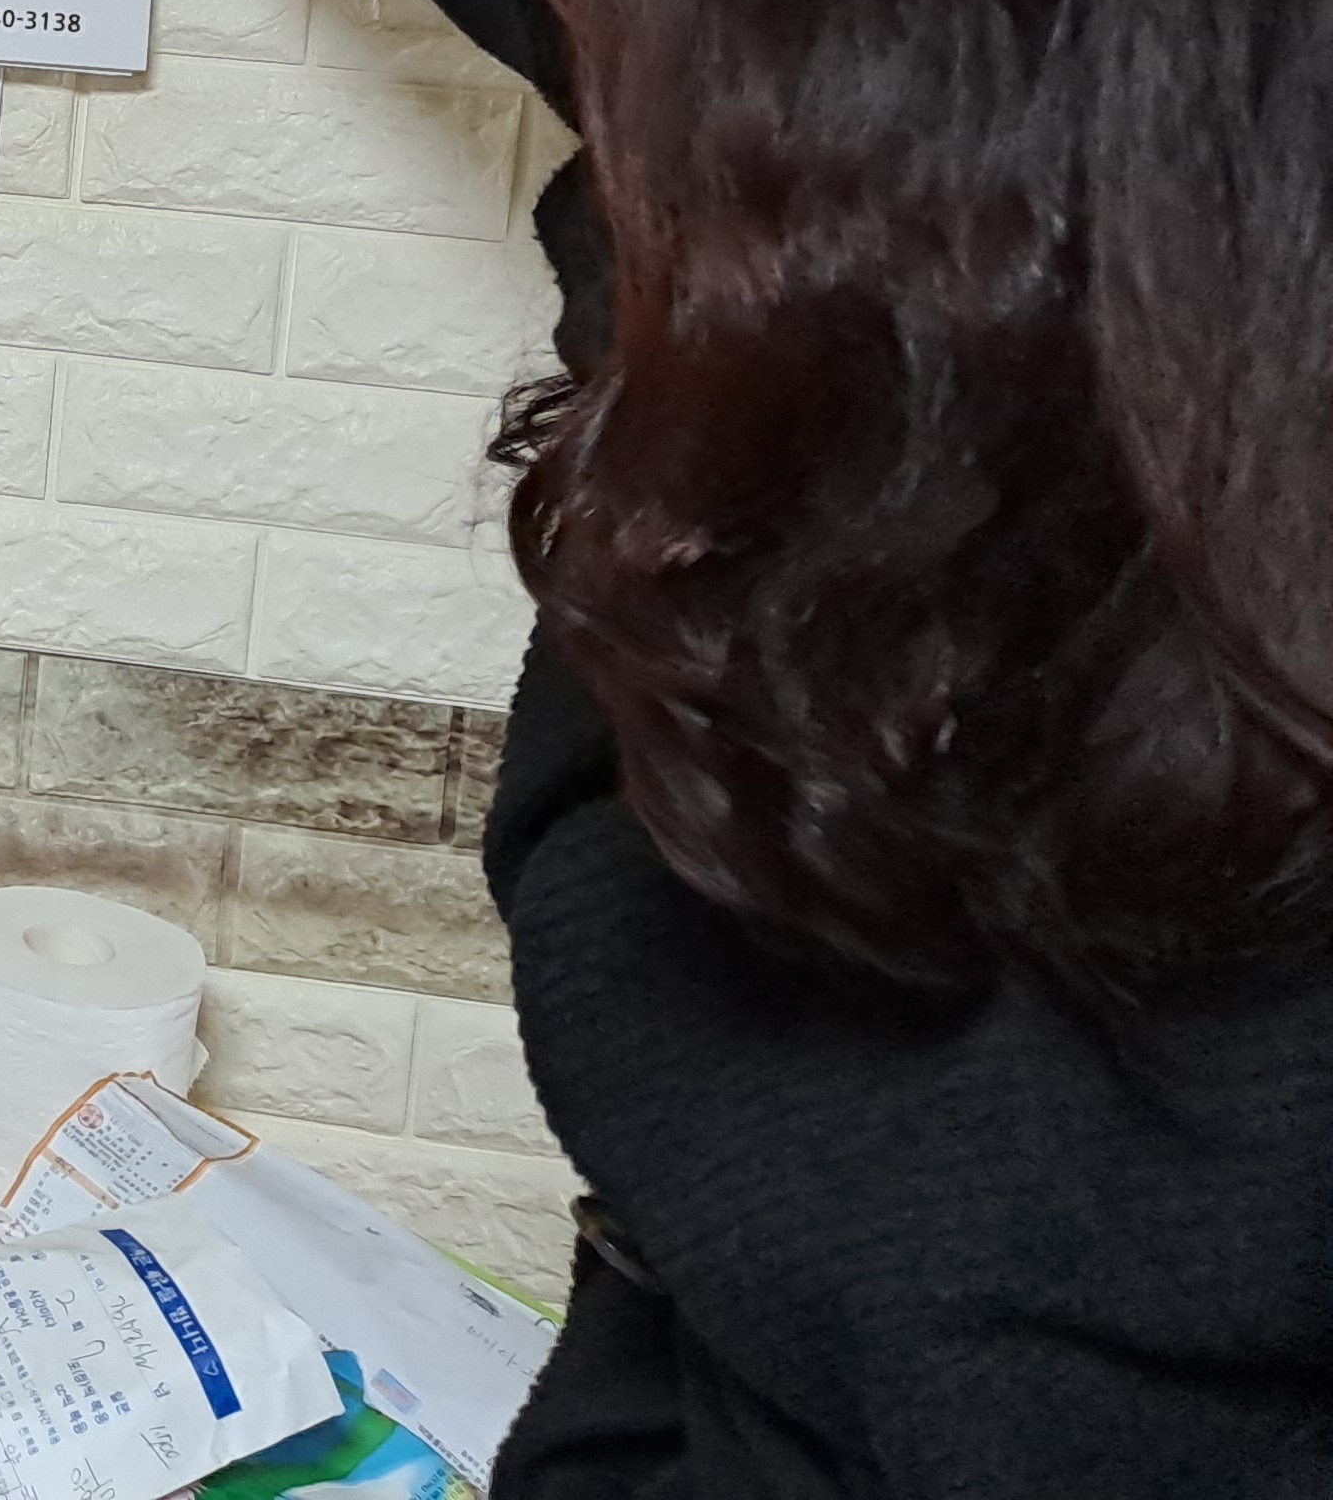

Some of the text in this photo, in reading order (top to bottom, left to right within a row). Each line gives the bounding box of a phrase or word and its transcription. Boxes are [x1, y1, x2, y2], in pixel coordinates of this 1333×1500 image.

[4, 1289, 31, 1328] 흔들어서
[28, 1287, 56, 1328] 시간마다
[169, 1306, 208, 1357] 빕니다
[152, 1382, 169, 1399] 님
[67, 1410, 87, 1435] 복용
[89, 1399, 109, 1424] 복용
